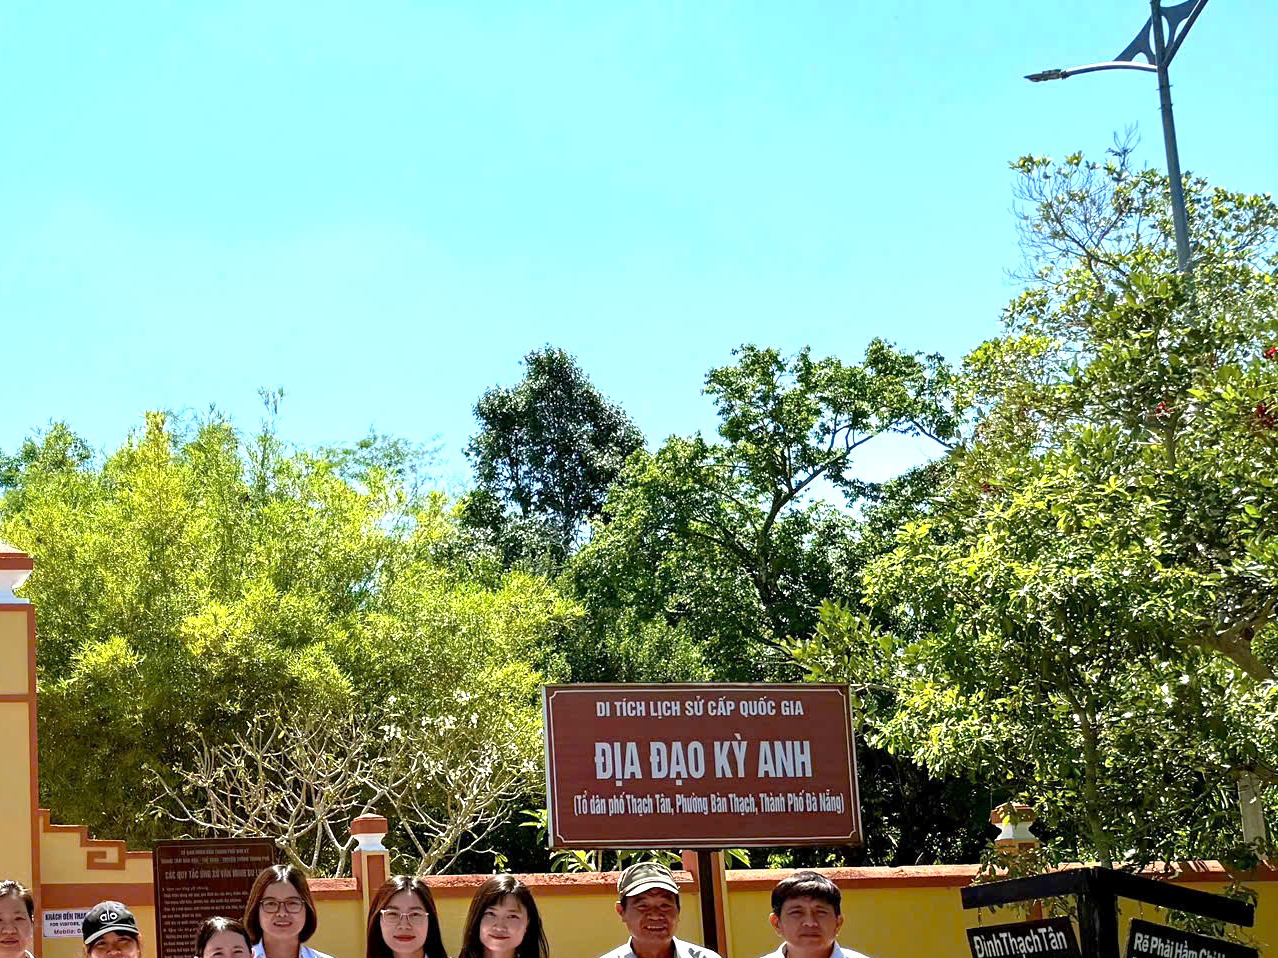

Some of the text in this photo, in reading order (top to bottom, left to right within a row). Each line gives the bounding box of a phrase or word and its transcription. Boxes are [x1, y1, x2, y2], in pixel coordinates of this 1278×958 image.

[596, 695, 805, 719] DI TÍCH LỊCH SỬ CẤP QUỐC GIA
[594, 733, 813, 787] ĐỊA ĐẠO KỲ ANH
[573, 789, 845, 817] (Tổ dân phố Thạch Tân, Phường Bàn Thạch, Thành Phố Đà Nẵng)
[1133, 932, 1149, 952] Rẽ
[1149, 936, 1175, 958] Phải
